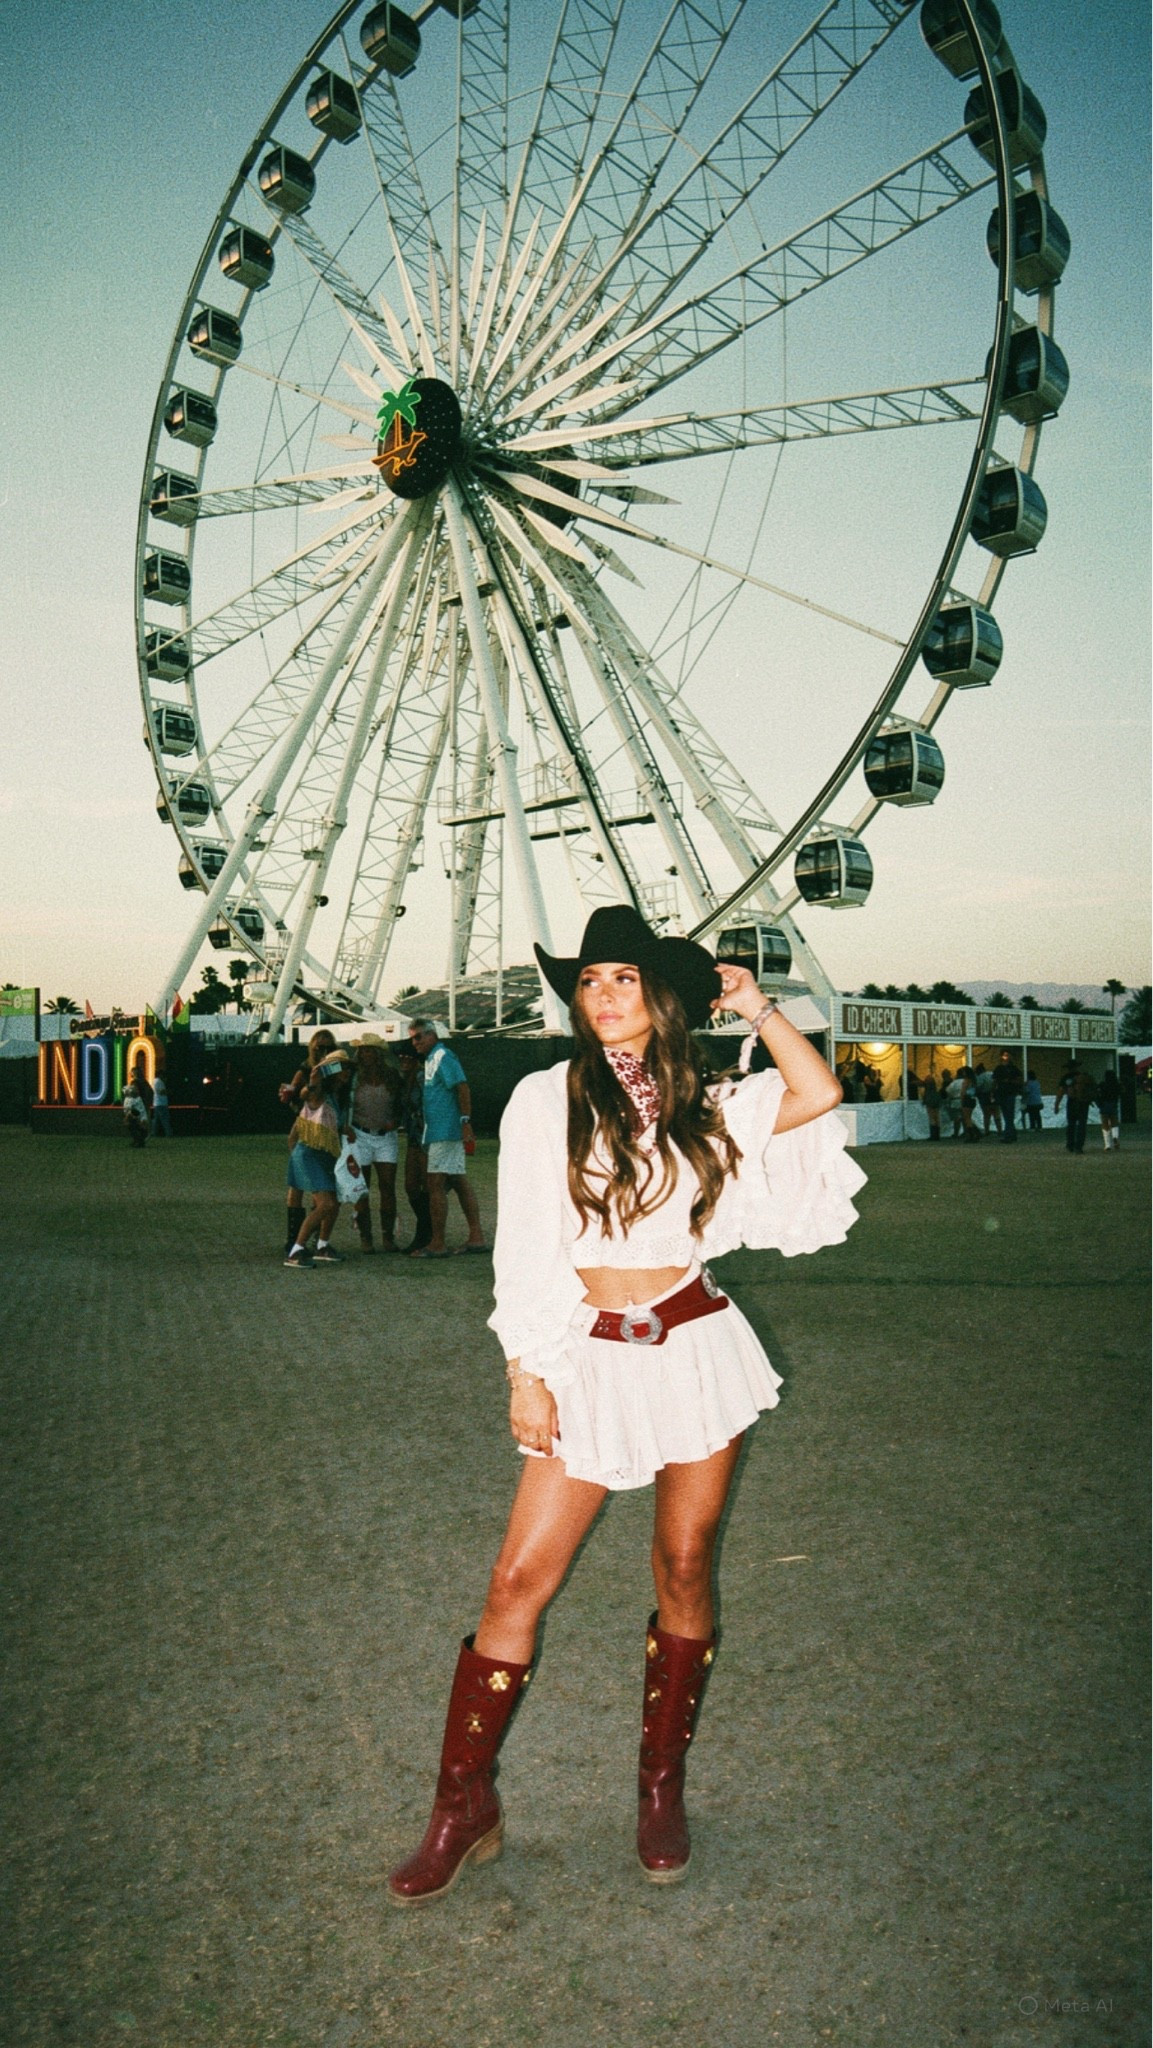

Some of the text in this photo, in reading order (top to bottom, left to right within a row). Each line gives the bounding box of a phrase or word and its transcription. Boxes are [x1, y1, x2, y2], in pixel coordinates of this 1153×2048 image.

[847, 1006, 898, 1033] ID CHECK
[916, 1010, 963, 1035] ID CHECK
[980, 1013, 1019, 1038] ID CHECK
[1033, 1016, 1068, 1039] ID CHECK
[38, 1035, 156, 1105] INDIO
